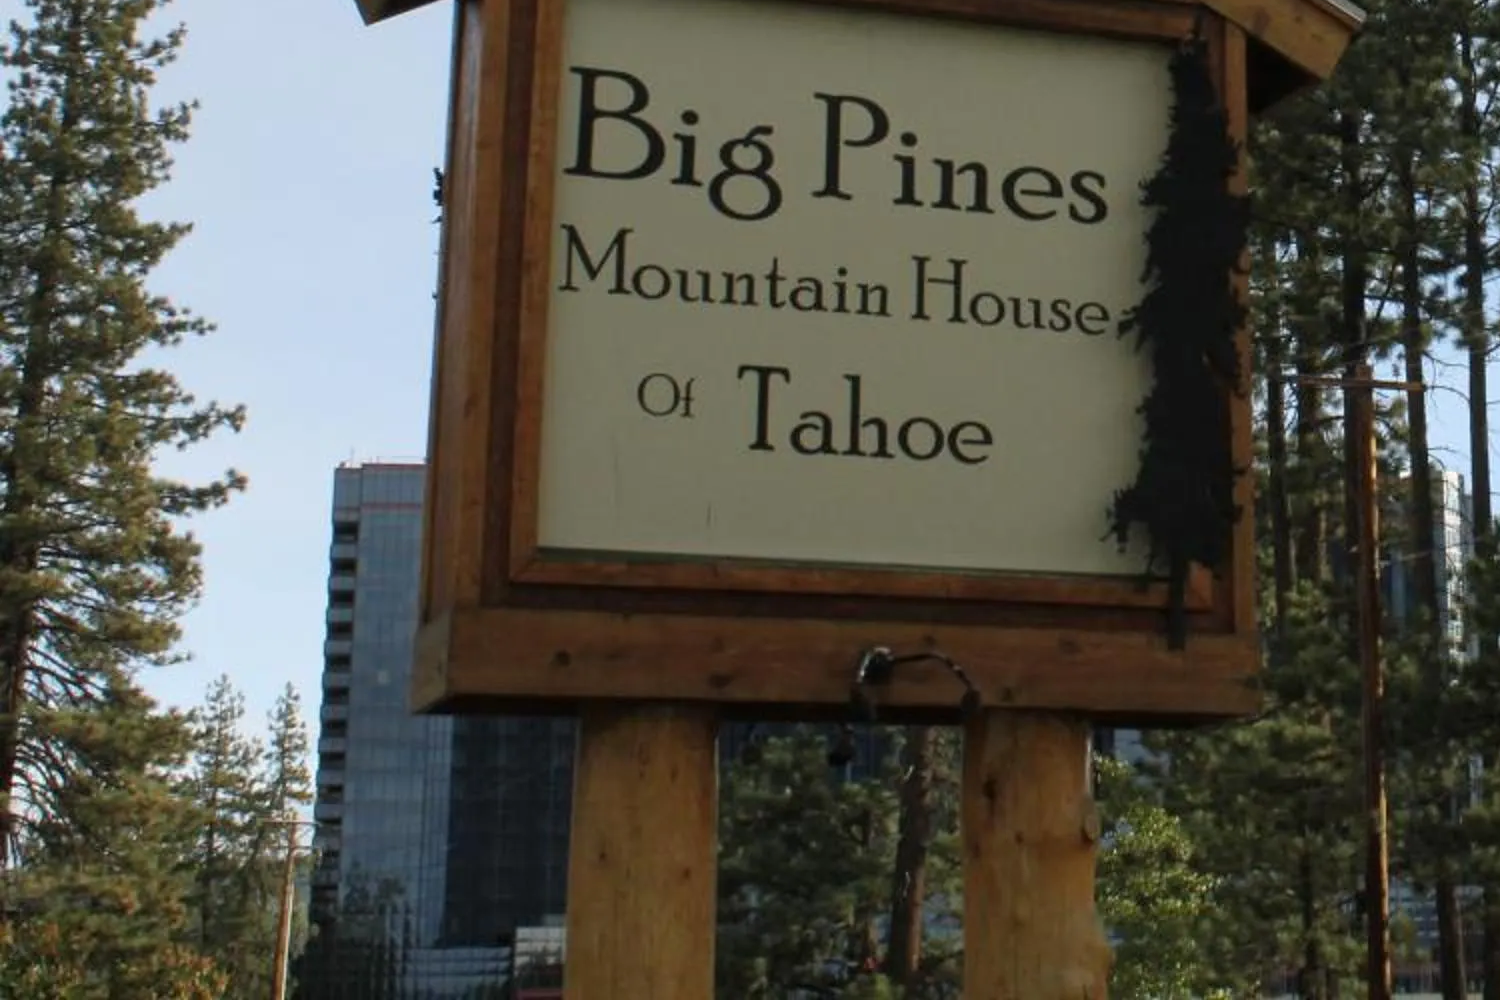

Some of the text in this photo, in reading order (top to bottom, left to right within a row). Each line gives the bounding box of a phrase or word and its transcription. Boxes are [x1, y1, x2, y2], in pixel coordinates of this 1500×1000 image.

[562, 65, 1109, 225] Big Pines
[557, 223, 1111, 336] Mountain House
[637, 364, 993, 465] Of Tahoe
